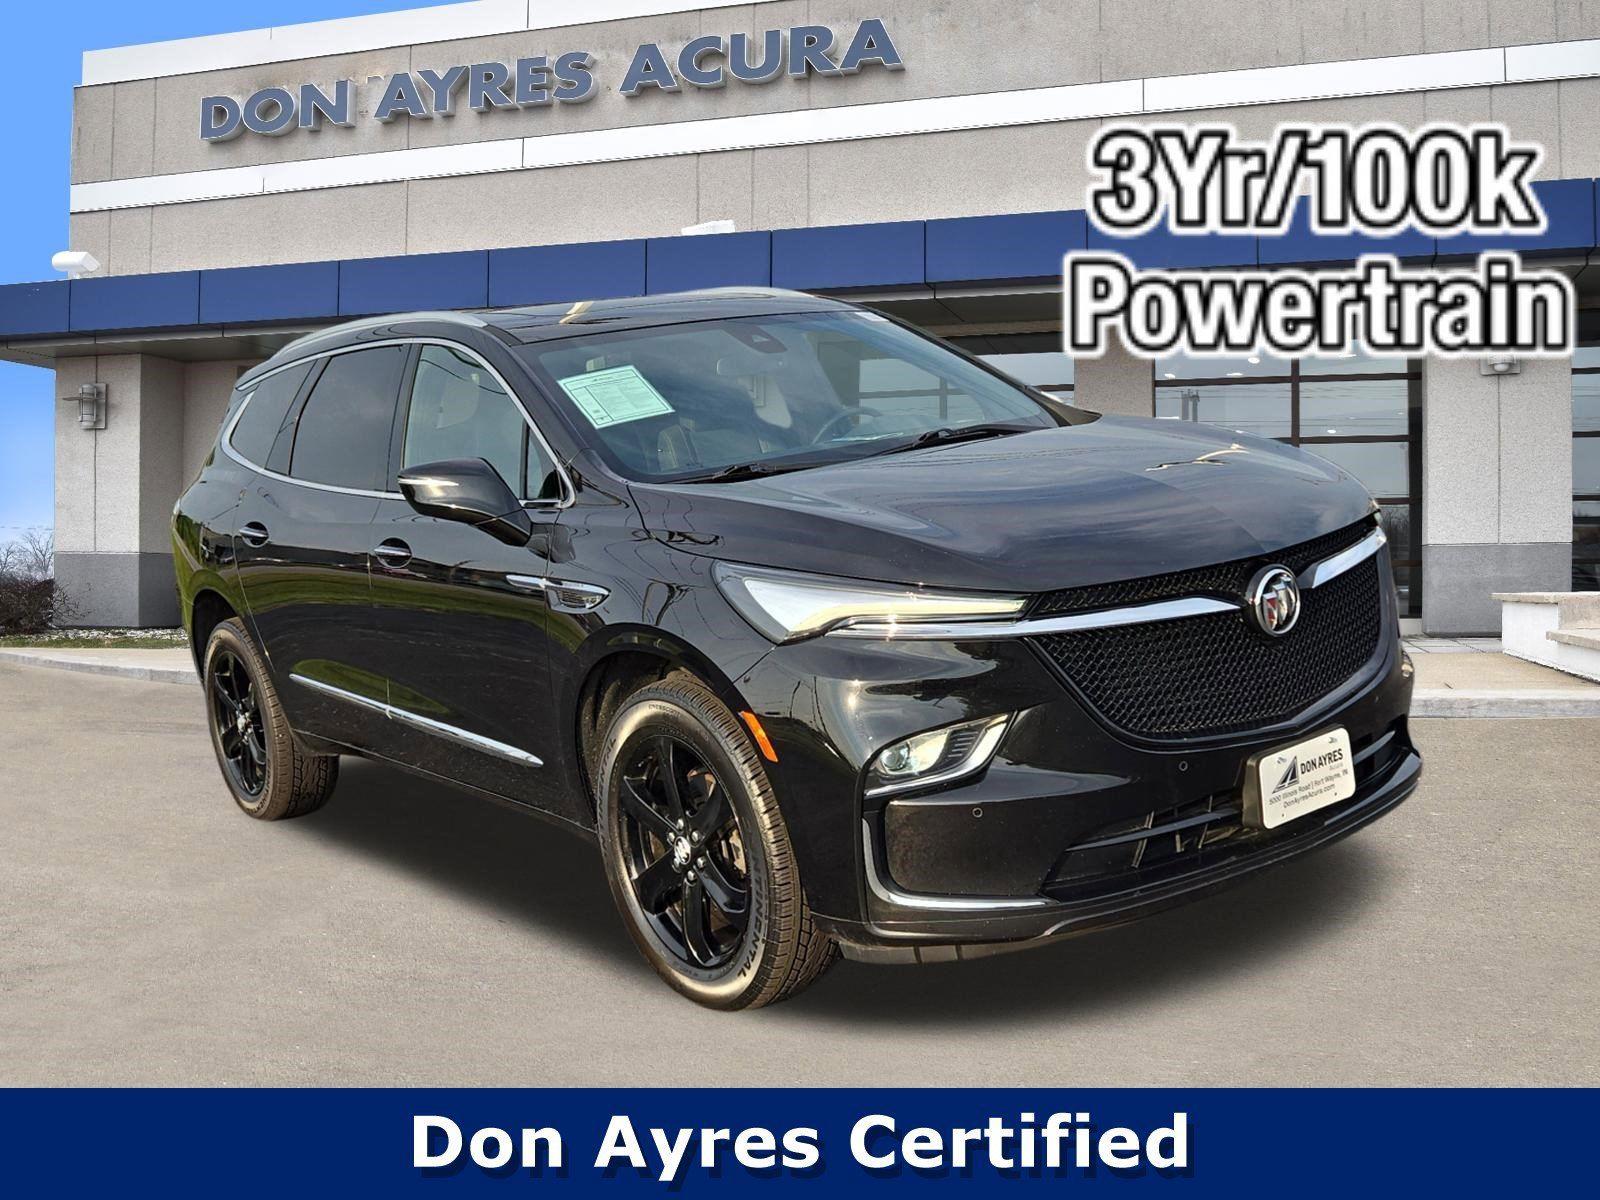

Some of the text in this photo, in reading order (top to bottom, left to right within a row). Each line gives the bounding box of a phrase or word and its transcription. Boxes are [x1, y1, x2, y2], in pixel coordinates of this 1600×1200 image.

[200, 18, 905, 141] DON AYRES ACURA
[1300, 748, 1343, 774] DON AYRES
